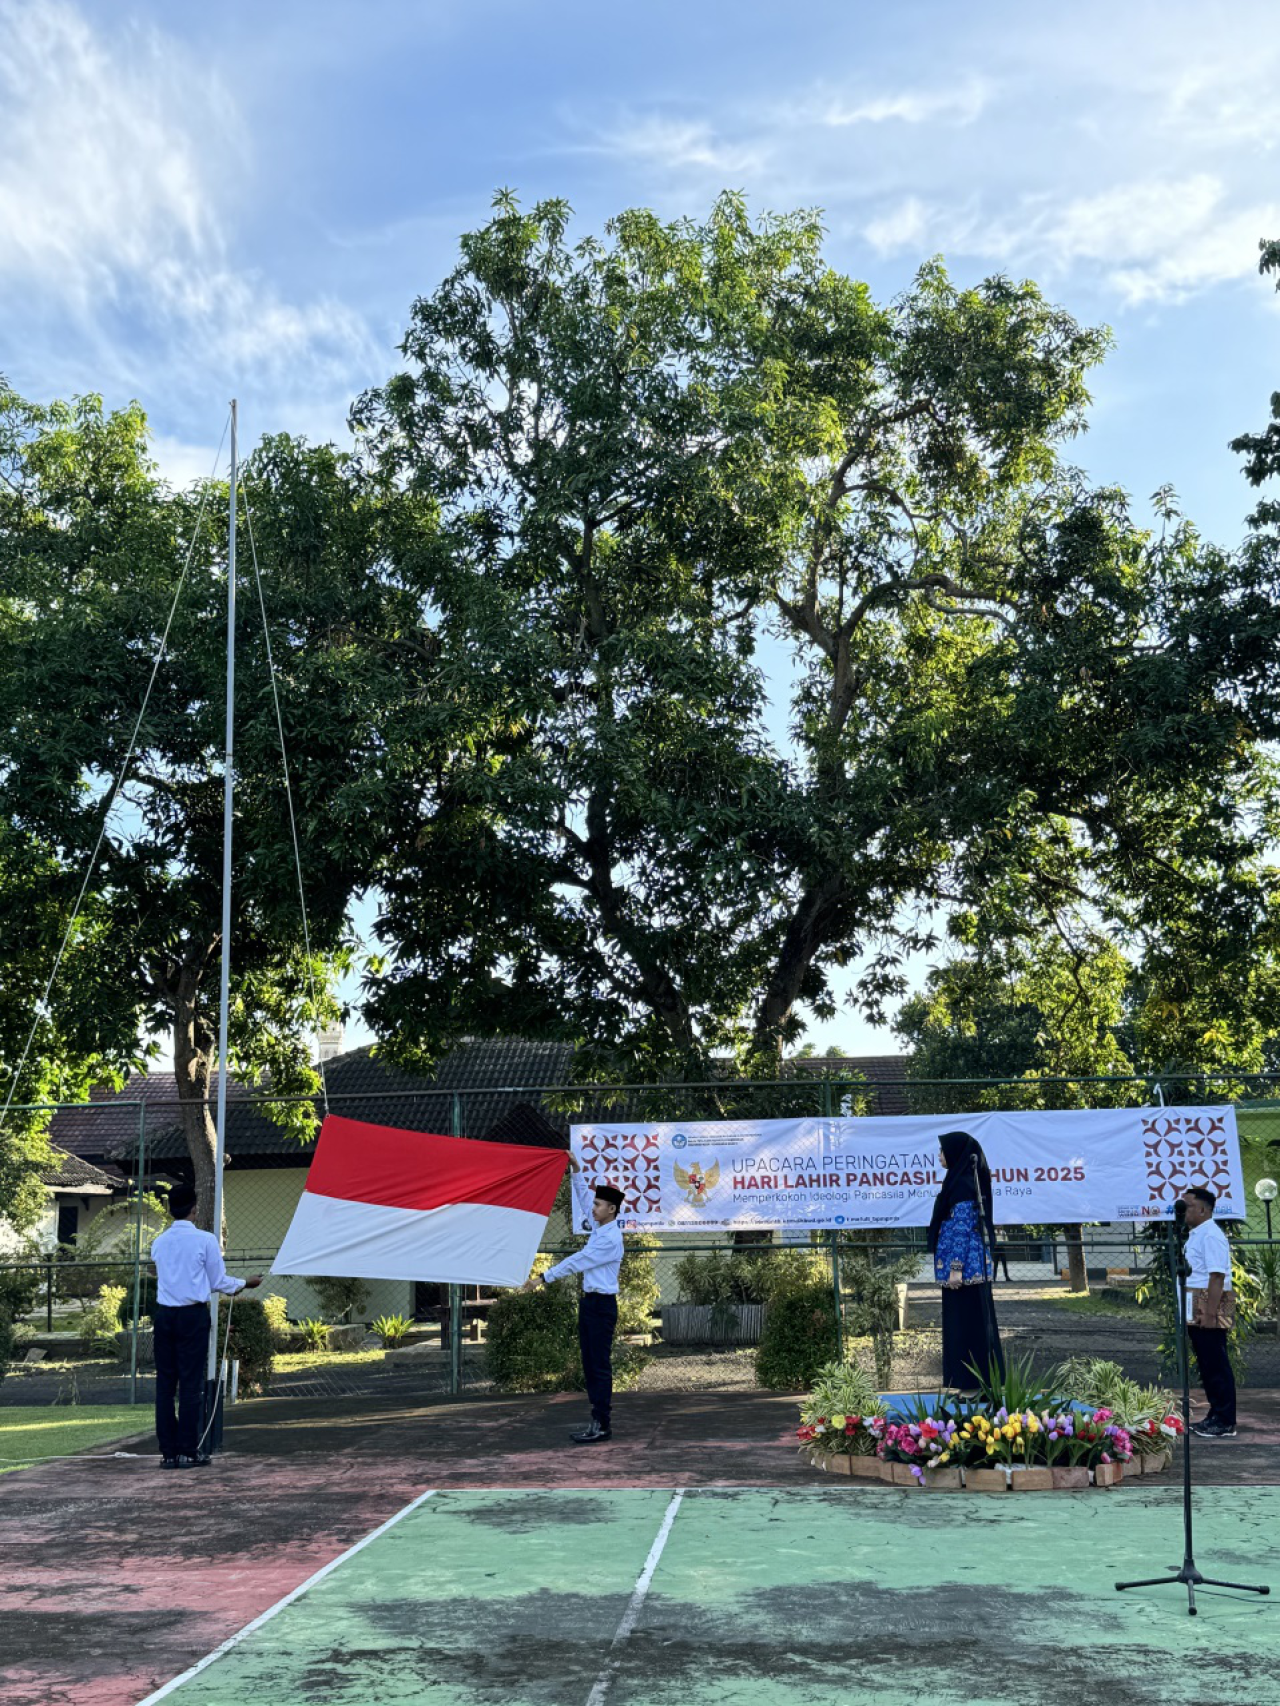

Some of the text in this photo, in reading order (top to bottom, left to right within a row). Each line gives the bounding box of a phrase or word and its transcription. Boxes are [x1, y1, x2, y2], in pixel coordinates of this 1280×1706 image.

[732, 1152, 935, 1173] UPACARA PERINGATAN
[733, 1166, 1086, 1189] HARI LAHIR PANCASIL HUN 2025
[732, 1192, 807, 1204] Memperkokoh
[810, 1189, 851, 1203] Ideologi
[854, 1188, 904, 1200] Pancasila
[1005, 1186, 1033, 1198] Raya
